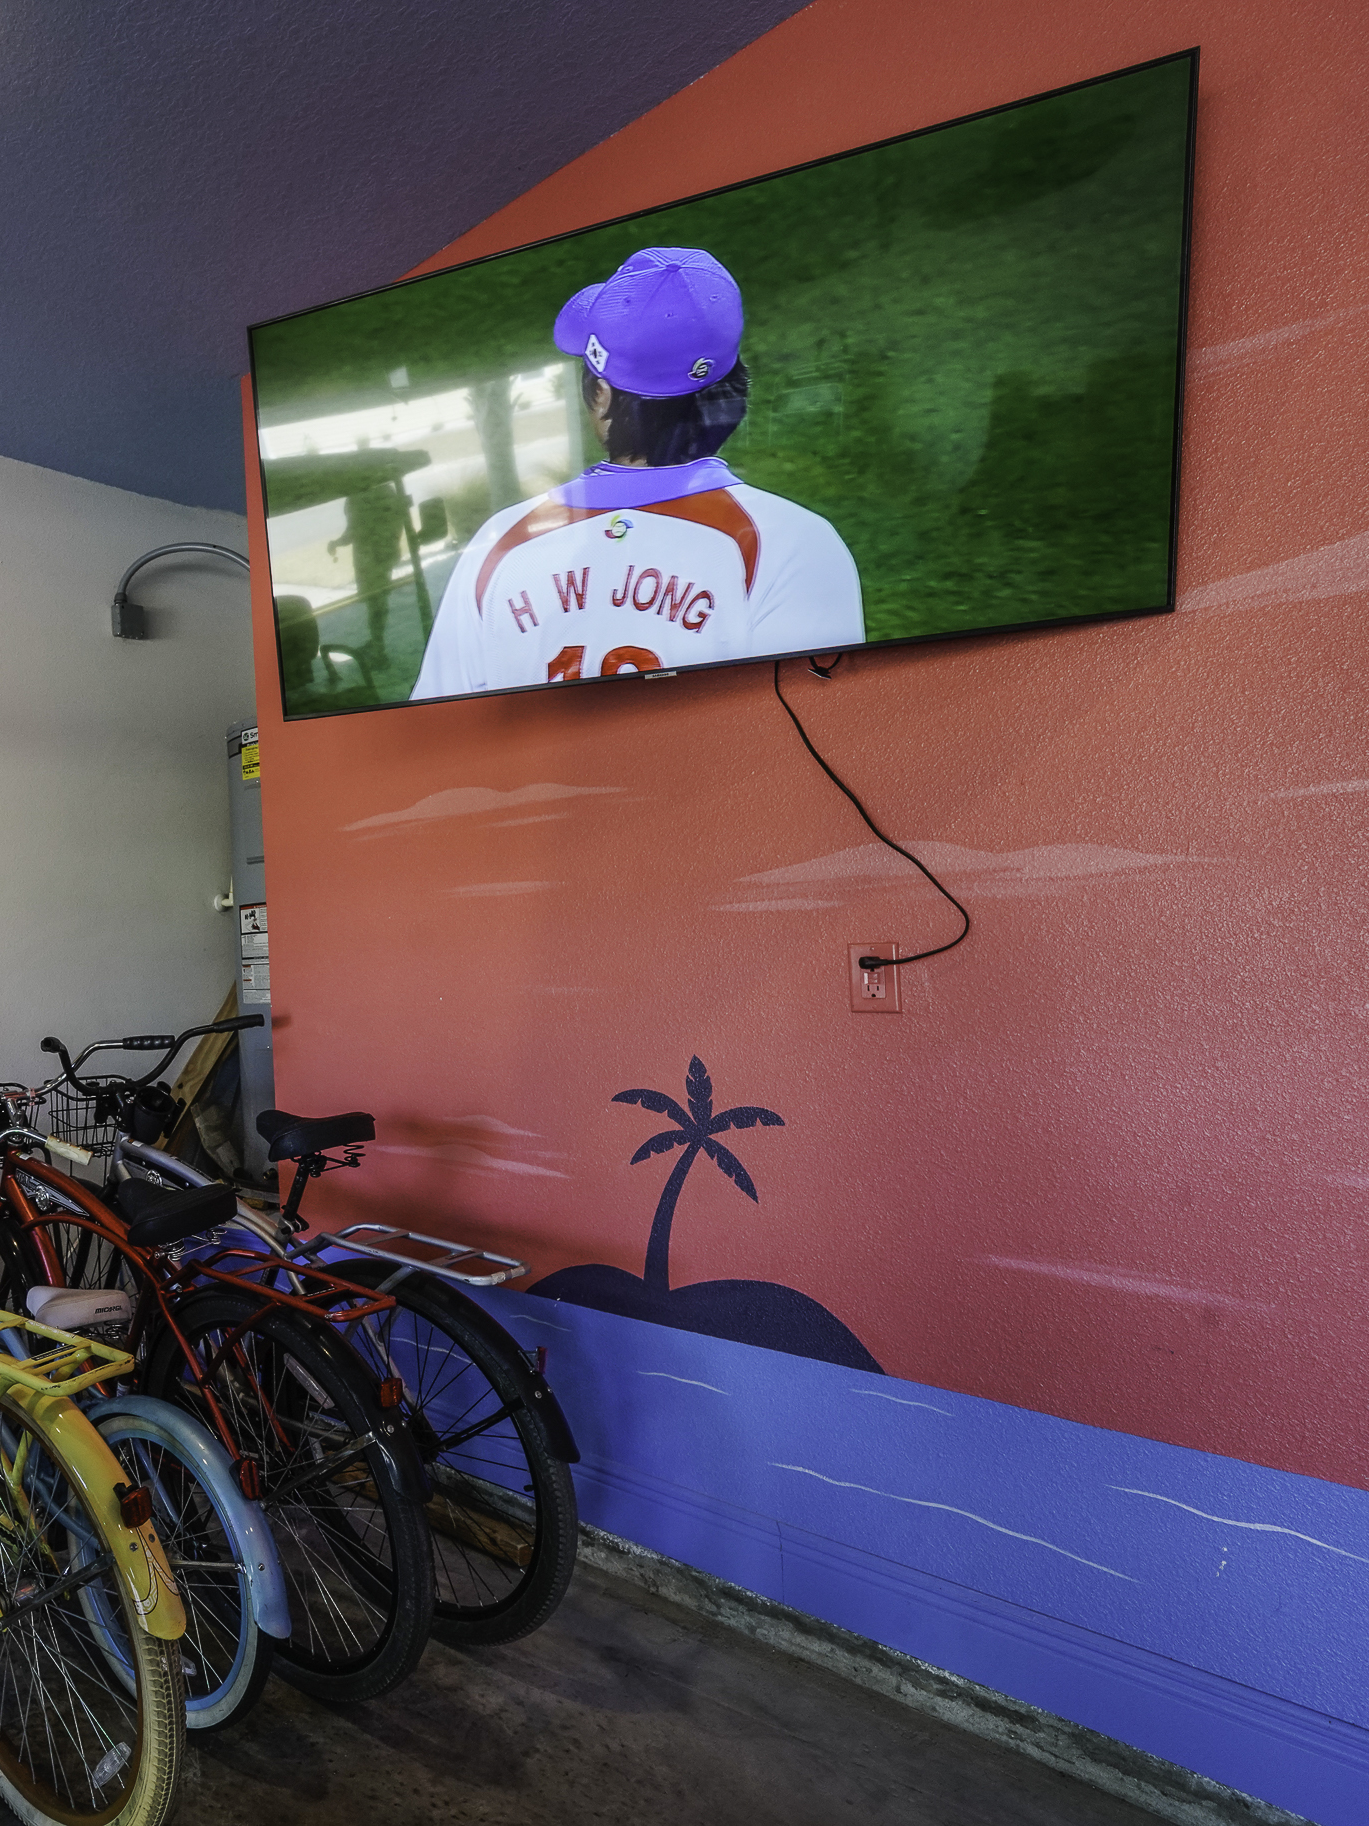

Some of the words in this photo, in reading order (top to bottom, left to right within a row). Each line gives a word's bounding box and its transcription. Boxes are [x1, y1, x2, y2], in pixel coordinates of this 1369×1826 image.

[507, 590, 540, 634] H
[552, 566, 591, 613] W
[611, 564, 716, 634] JONG
